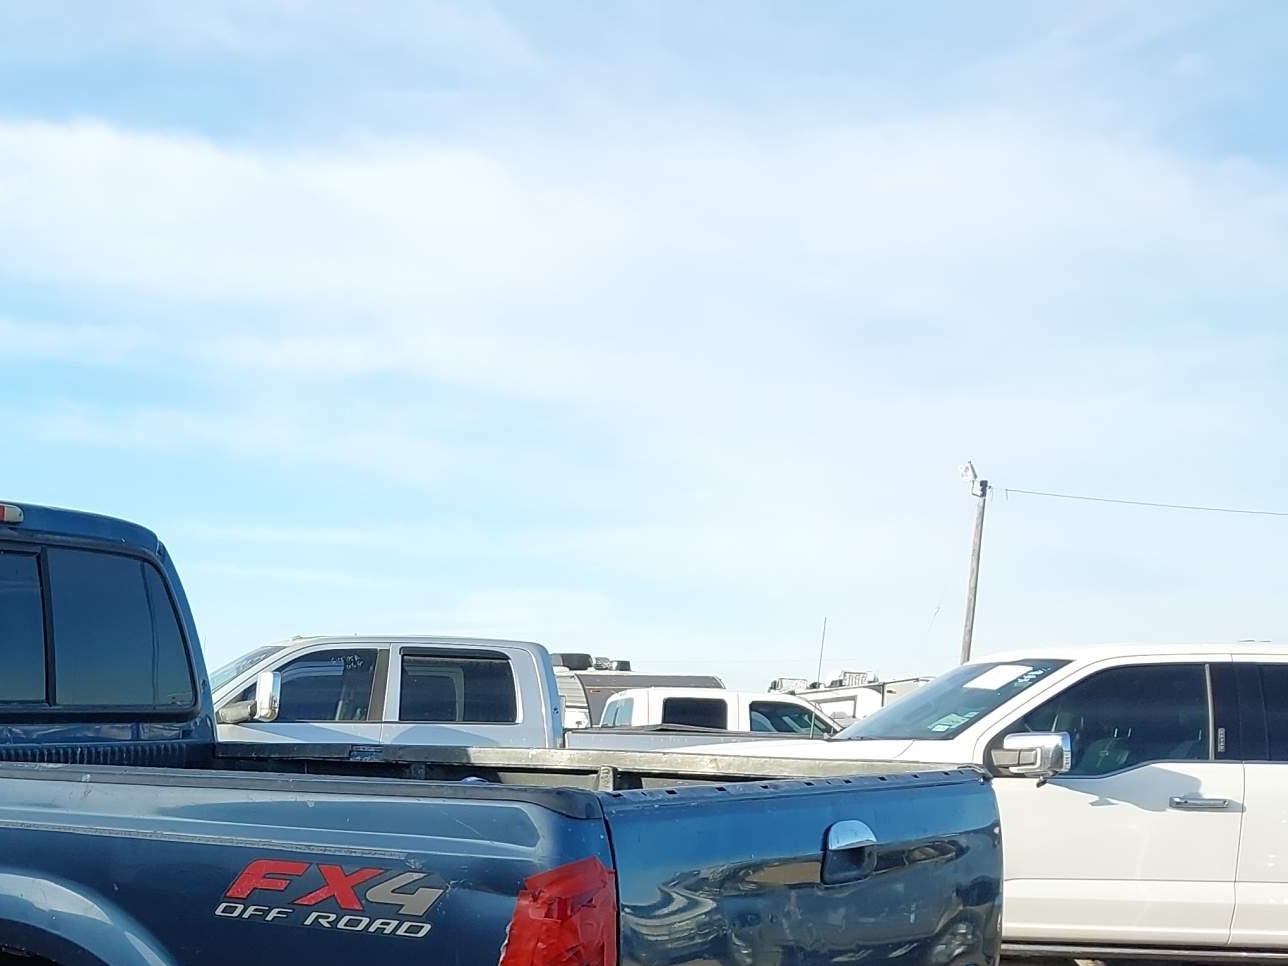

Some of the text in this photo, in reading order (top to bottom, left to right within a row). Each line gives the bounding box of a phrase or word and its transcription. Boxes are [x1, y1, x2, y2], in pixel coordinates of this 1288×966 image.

[225, 858, 449, 917] FX4
[214, 902, 433, 938] OFF ROAD
